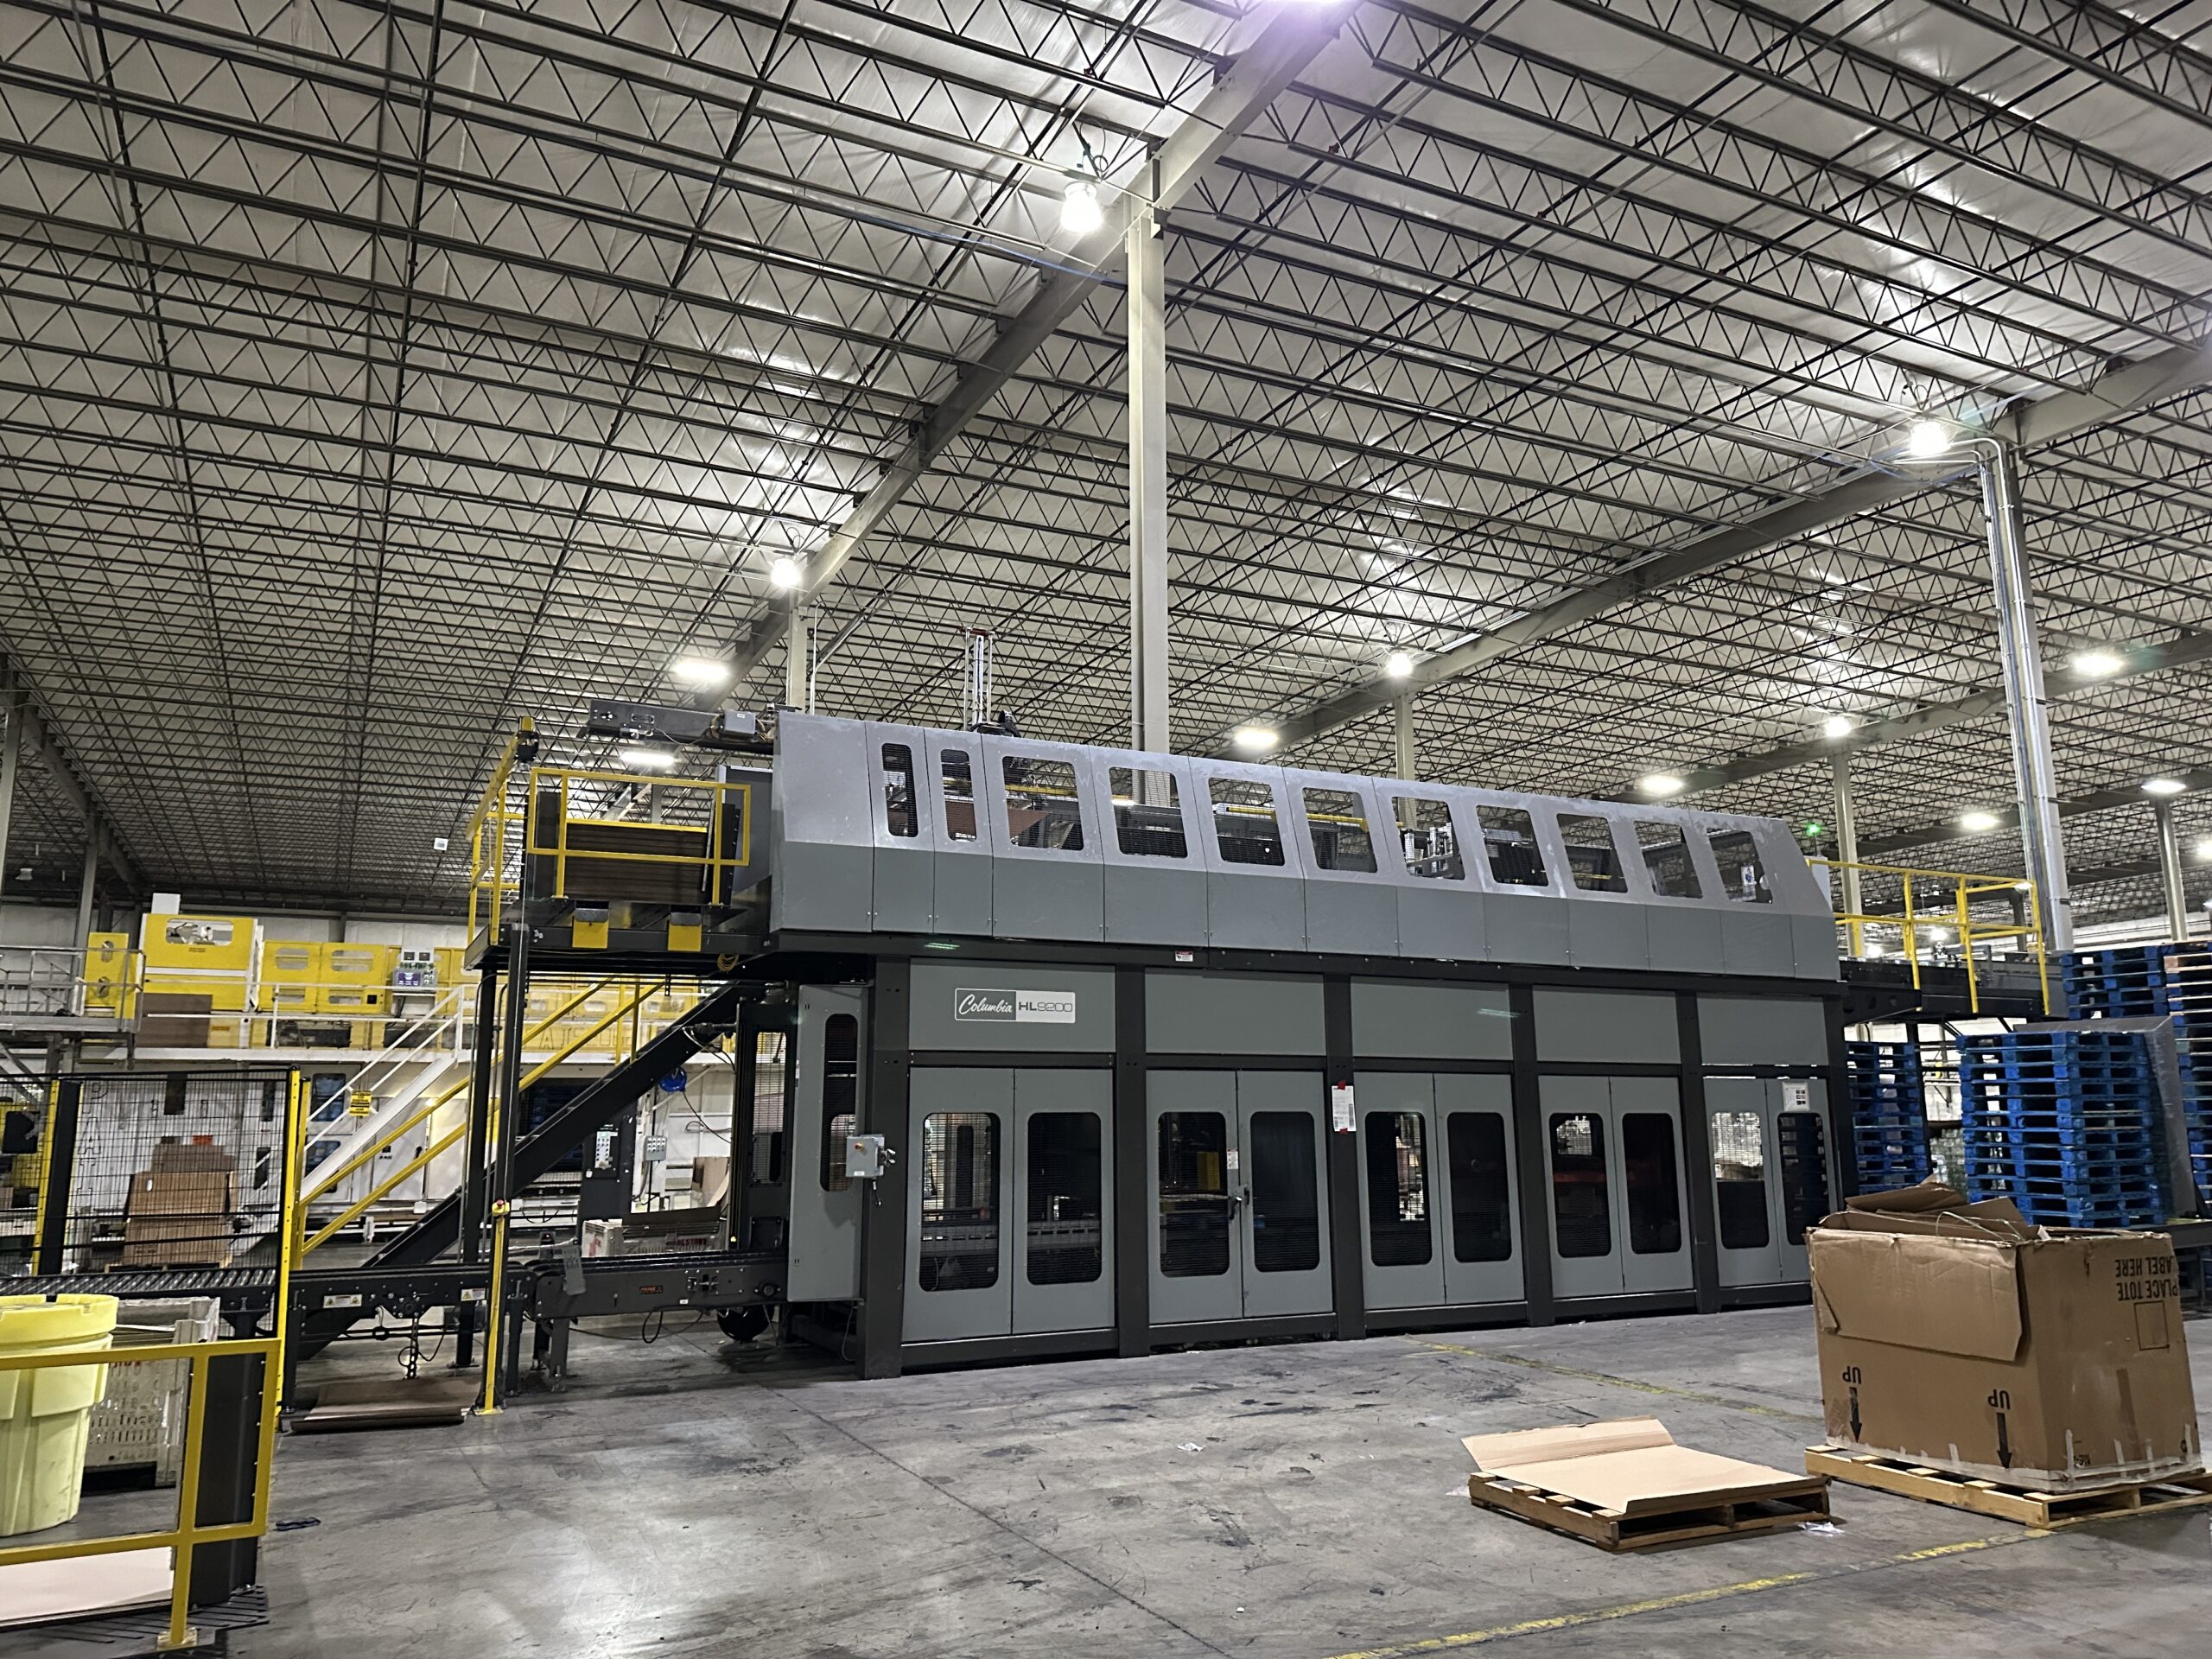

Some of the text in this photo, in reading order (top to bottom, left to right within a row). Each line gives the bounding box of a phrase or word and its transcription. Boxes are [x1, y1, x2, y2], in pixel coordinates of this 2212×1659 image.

[958, 994, 1073, 1015] Columbia HL9200
[2114, 1258, 2143, 1277] HERE
[2116, 1279, 2178, 1301] PLACE TOTE
[1842, 1365, 1862, 1384] UP
[1987, 1389, 2011, 1410] UP
